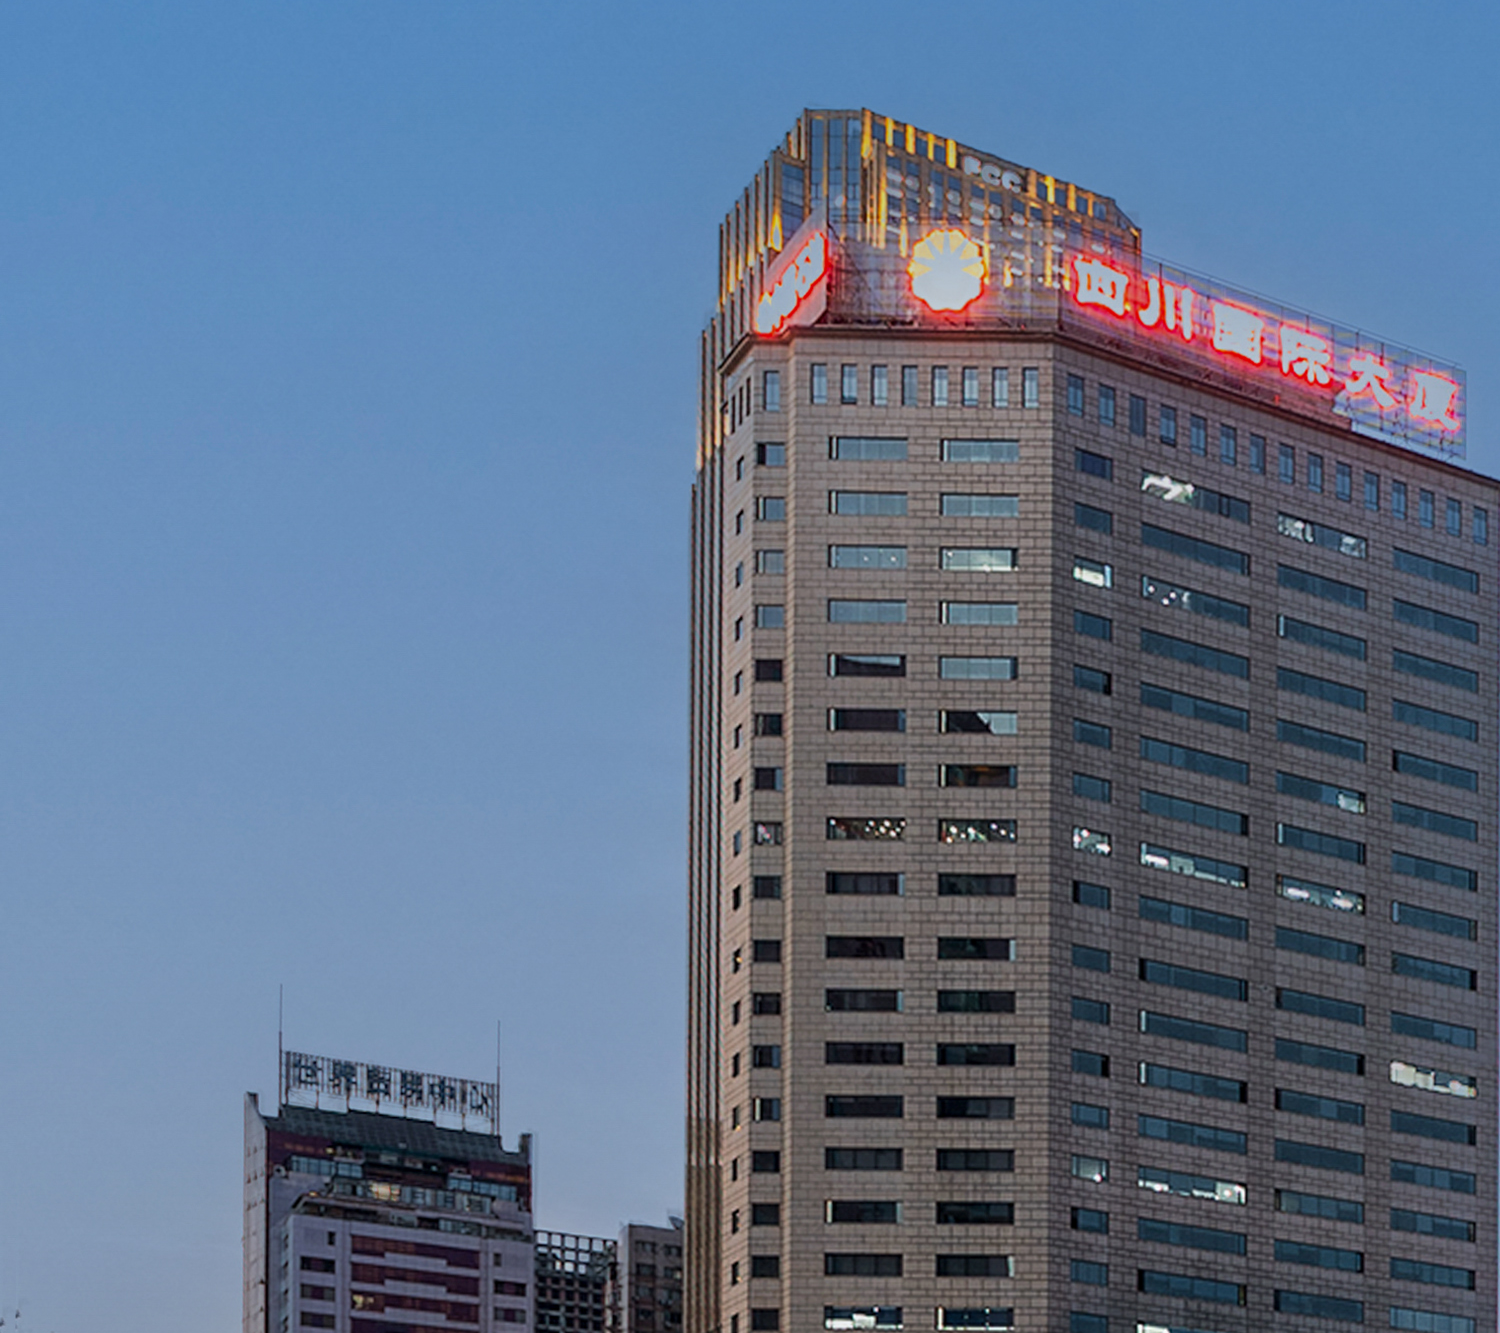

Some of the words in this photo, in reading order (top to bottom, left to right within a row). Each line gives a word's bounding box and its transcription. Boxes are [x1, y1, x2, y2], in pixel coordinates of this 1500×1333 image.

[1072, 254, 1462, 432] 四川国际大厦
